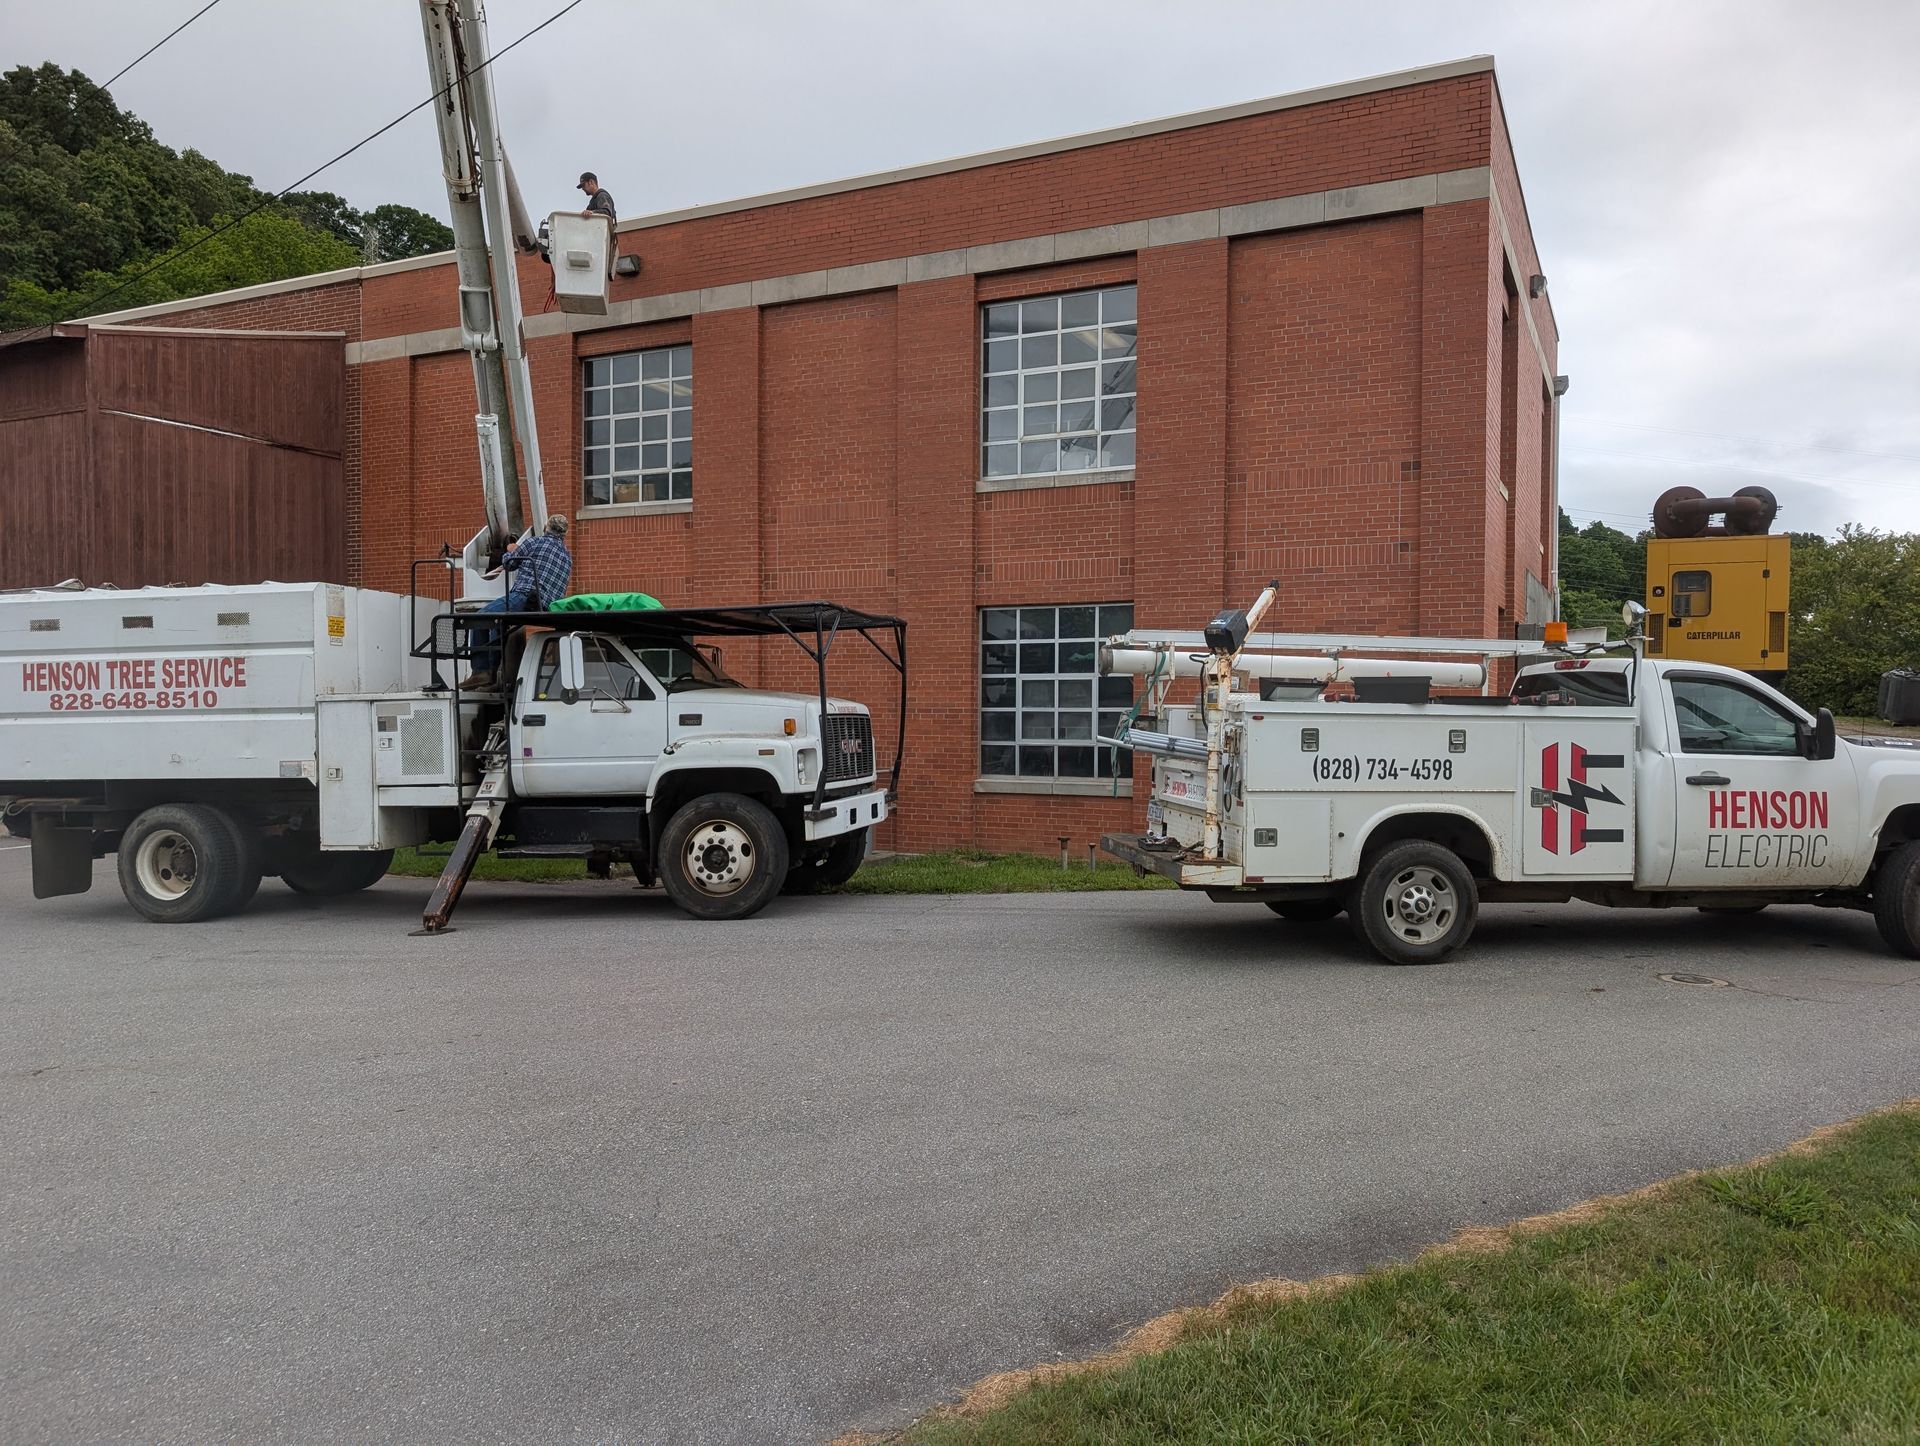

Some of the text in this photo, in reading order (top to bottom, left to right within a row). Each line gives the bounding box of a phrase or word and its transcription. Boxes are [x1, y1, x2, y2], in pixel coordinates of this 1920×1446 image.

[1686, 631, 1741, 640] CATERPILLAR
[22, 657, 247, 692] HENSON TREE SERVICE
[49, 690, 218, 711] 828-648-8510
[841, 739, 862, 753] GMC
[1312, 754, 1453, 783] (828) 734-4598
[1708, 790, 1828, 829] HENSON
[1704, 834, 1828, 868] ELECTRIC
